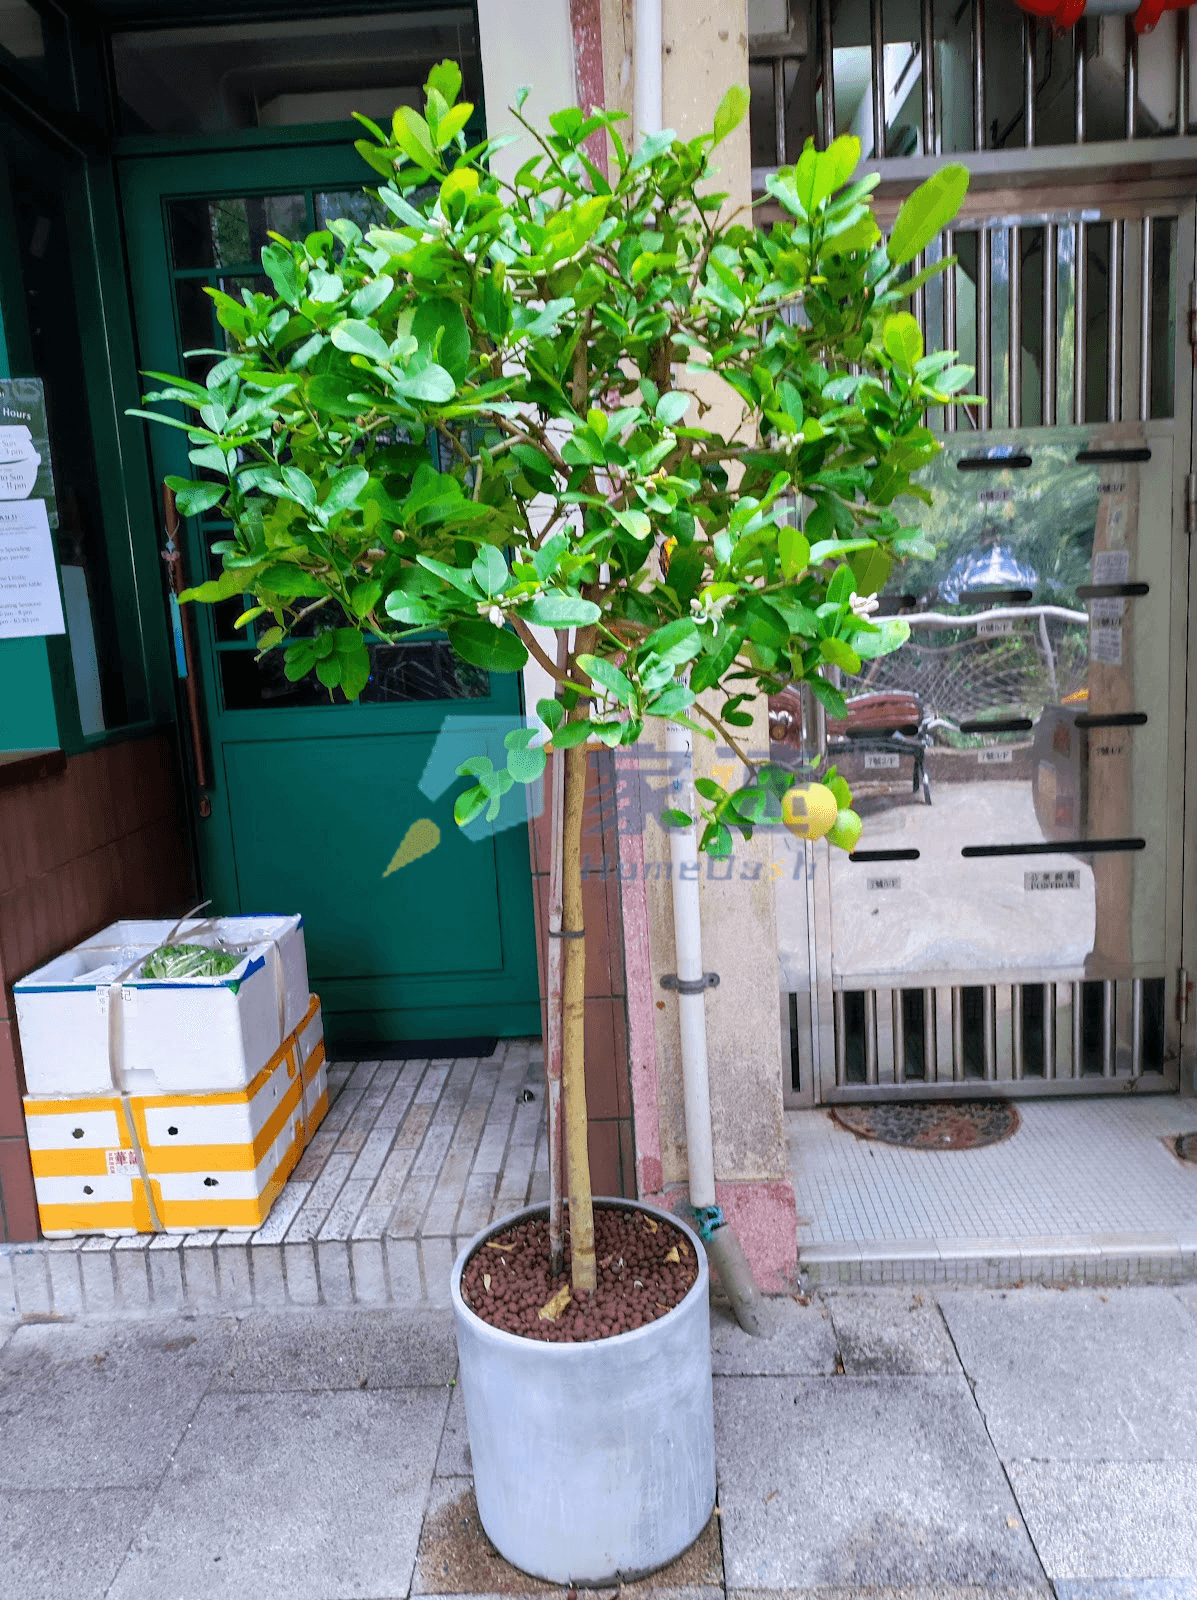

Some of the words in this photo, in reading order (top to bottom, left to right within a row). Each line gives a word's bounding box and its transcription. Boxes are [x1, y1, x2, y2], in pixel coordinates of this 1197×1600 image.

[3, 407, 31, 420] Hours
[9, 473, 24, 481] Sun
[1031, 882, 1074, 890] POSTBOX
